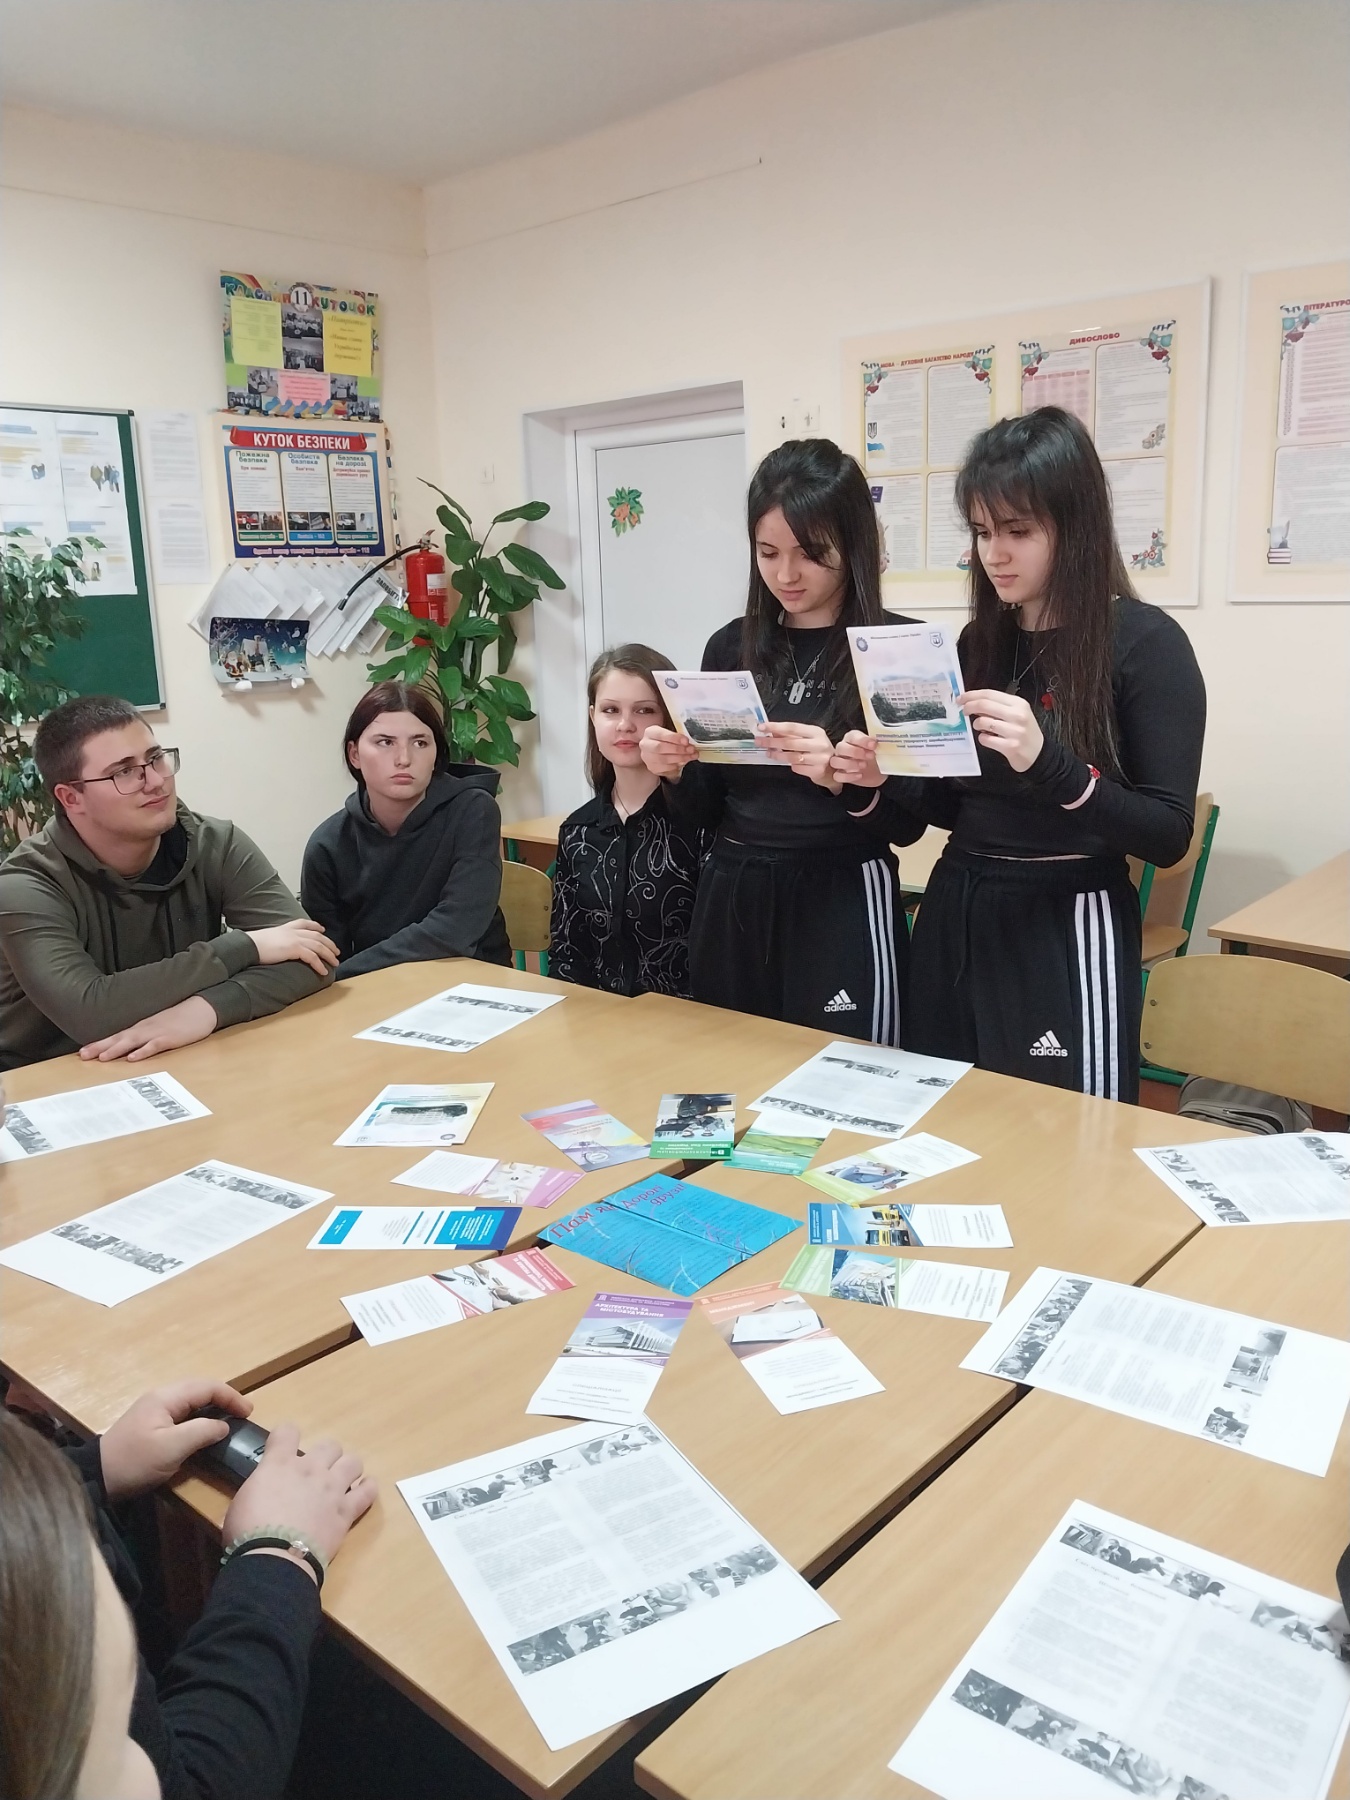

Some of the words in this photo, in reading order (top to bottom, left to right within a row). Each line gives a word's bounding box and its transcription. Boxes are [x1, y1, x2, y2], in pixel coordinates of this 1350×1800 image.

[295, 290, 308, 306] 11
[312, 296, 375, 316] КУТОЧОК
[1069, 333, 1120, 345] ДИВОСЛОВО
[254, 432, 294, 448] КУТОК
[297, 434, 350, 450] БЕЗПЕКИ
[824, 1003, 857, 1012] adidas
[1030, 1046, 1068, 1058] adidas
